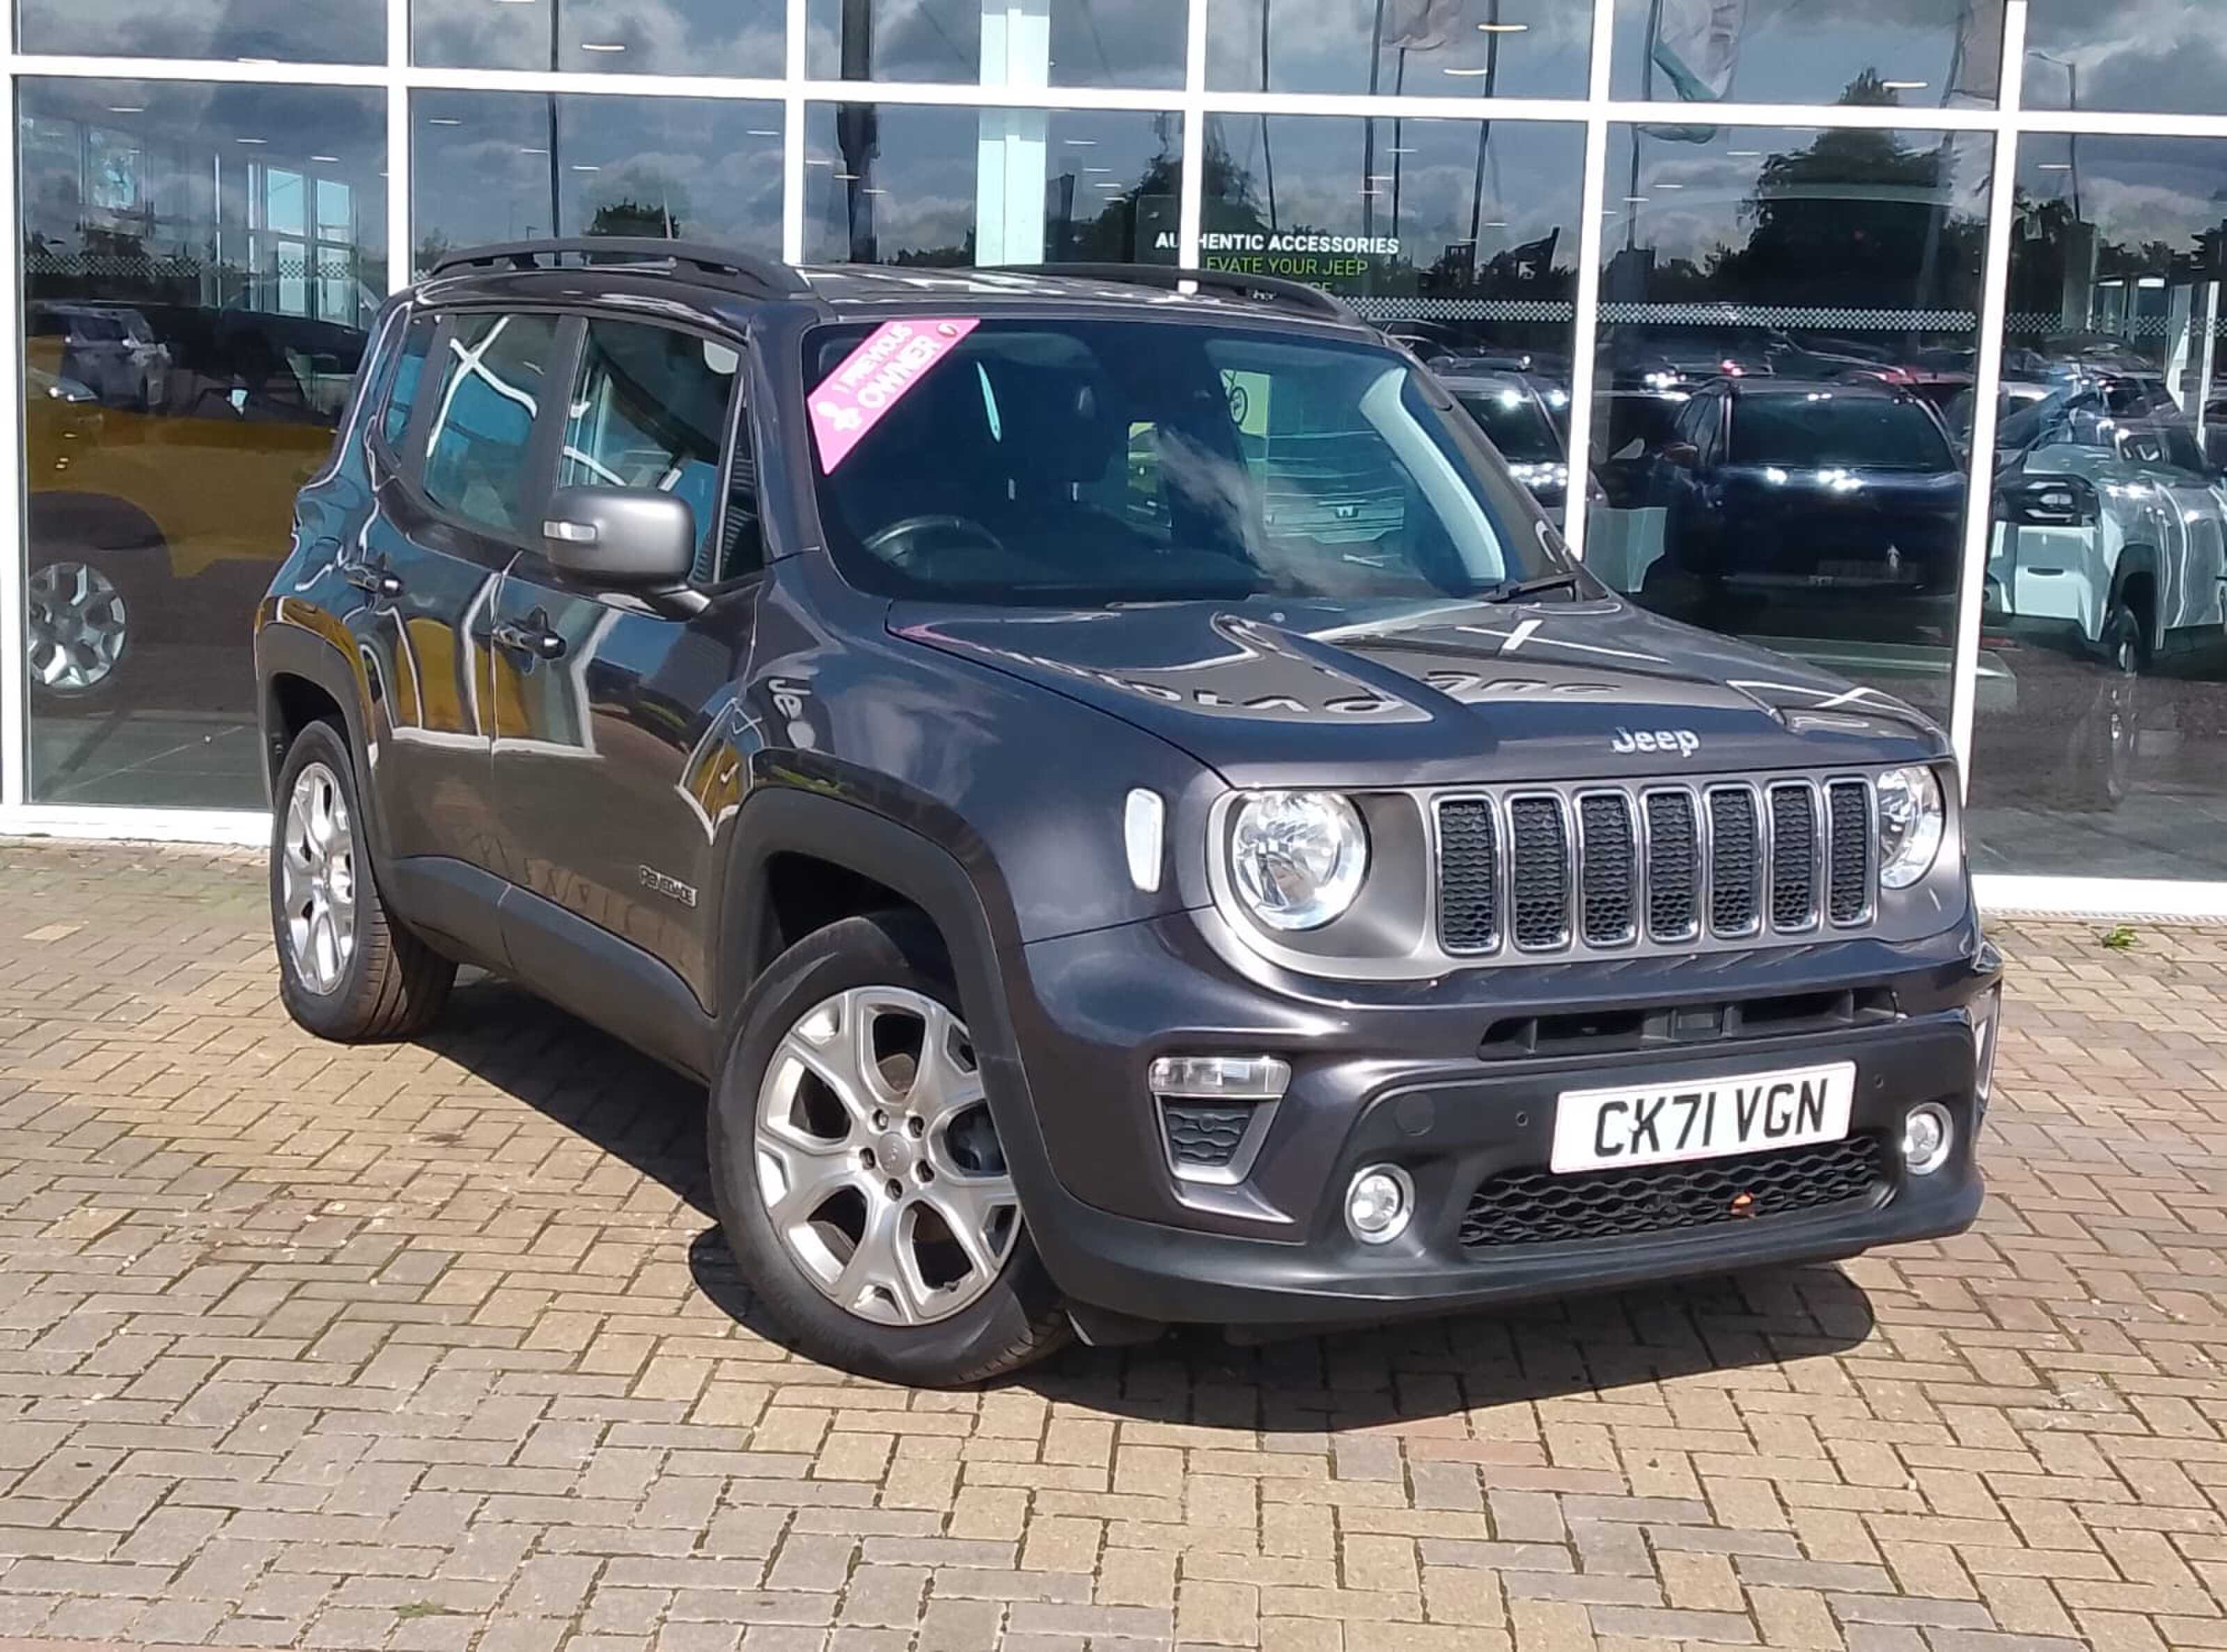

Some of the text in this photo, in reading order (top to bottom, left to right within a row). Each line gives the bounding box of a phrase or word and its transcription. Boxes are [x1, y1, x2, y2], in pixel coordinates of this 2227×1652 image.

[1267, 235, 1400, 254] ACCESSORIES
[1268, 258, 1318, 274] YOUR
[1322, 260, 1368, 276] JEEP
[857, 335, 941, 409] OWNER
[1609, 726, 1700, 758] Jeep
